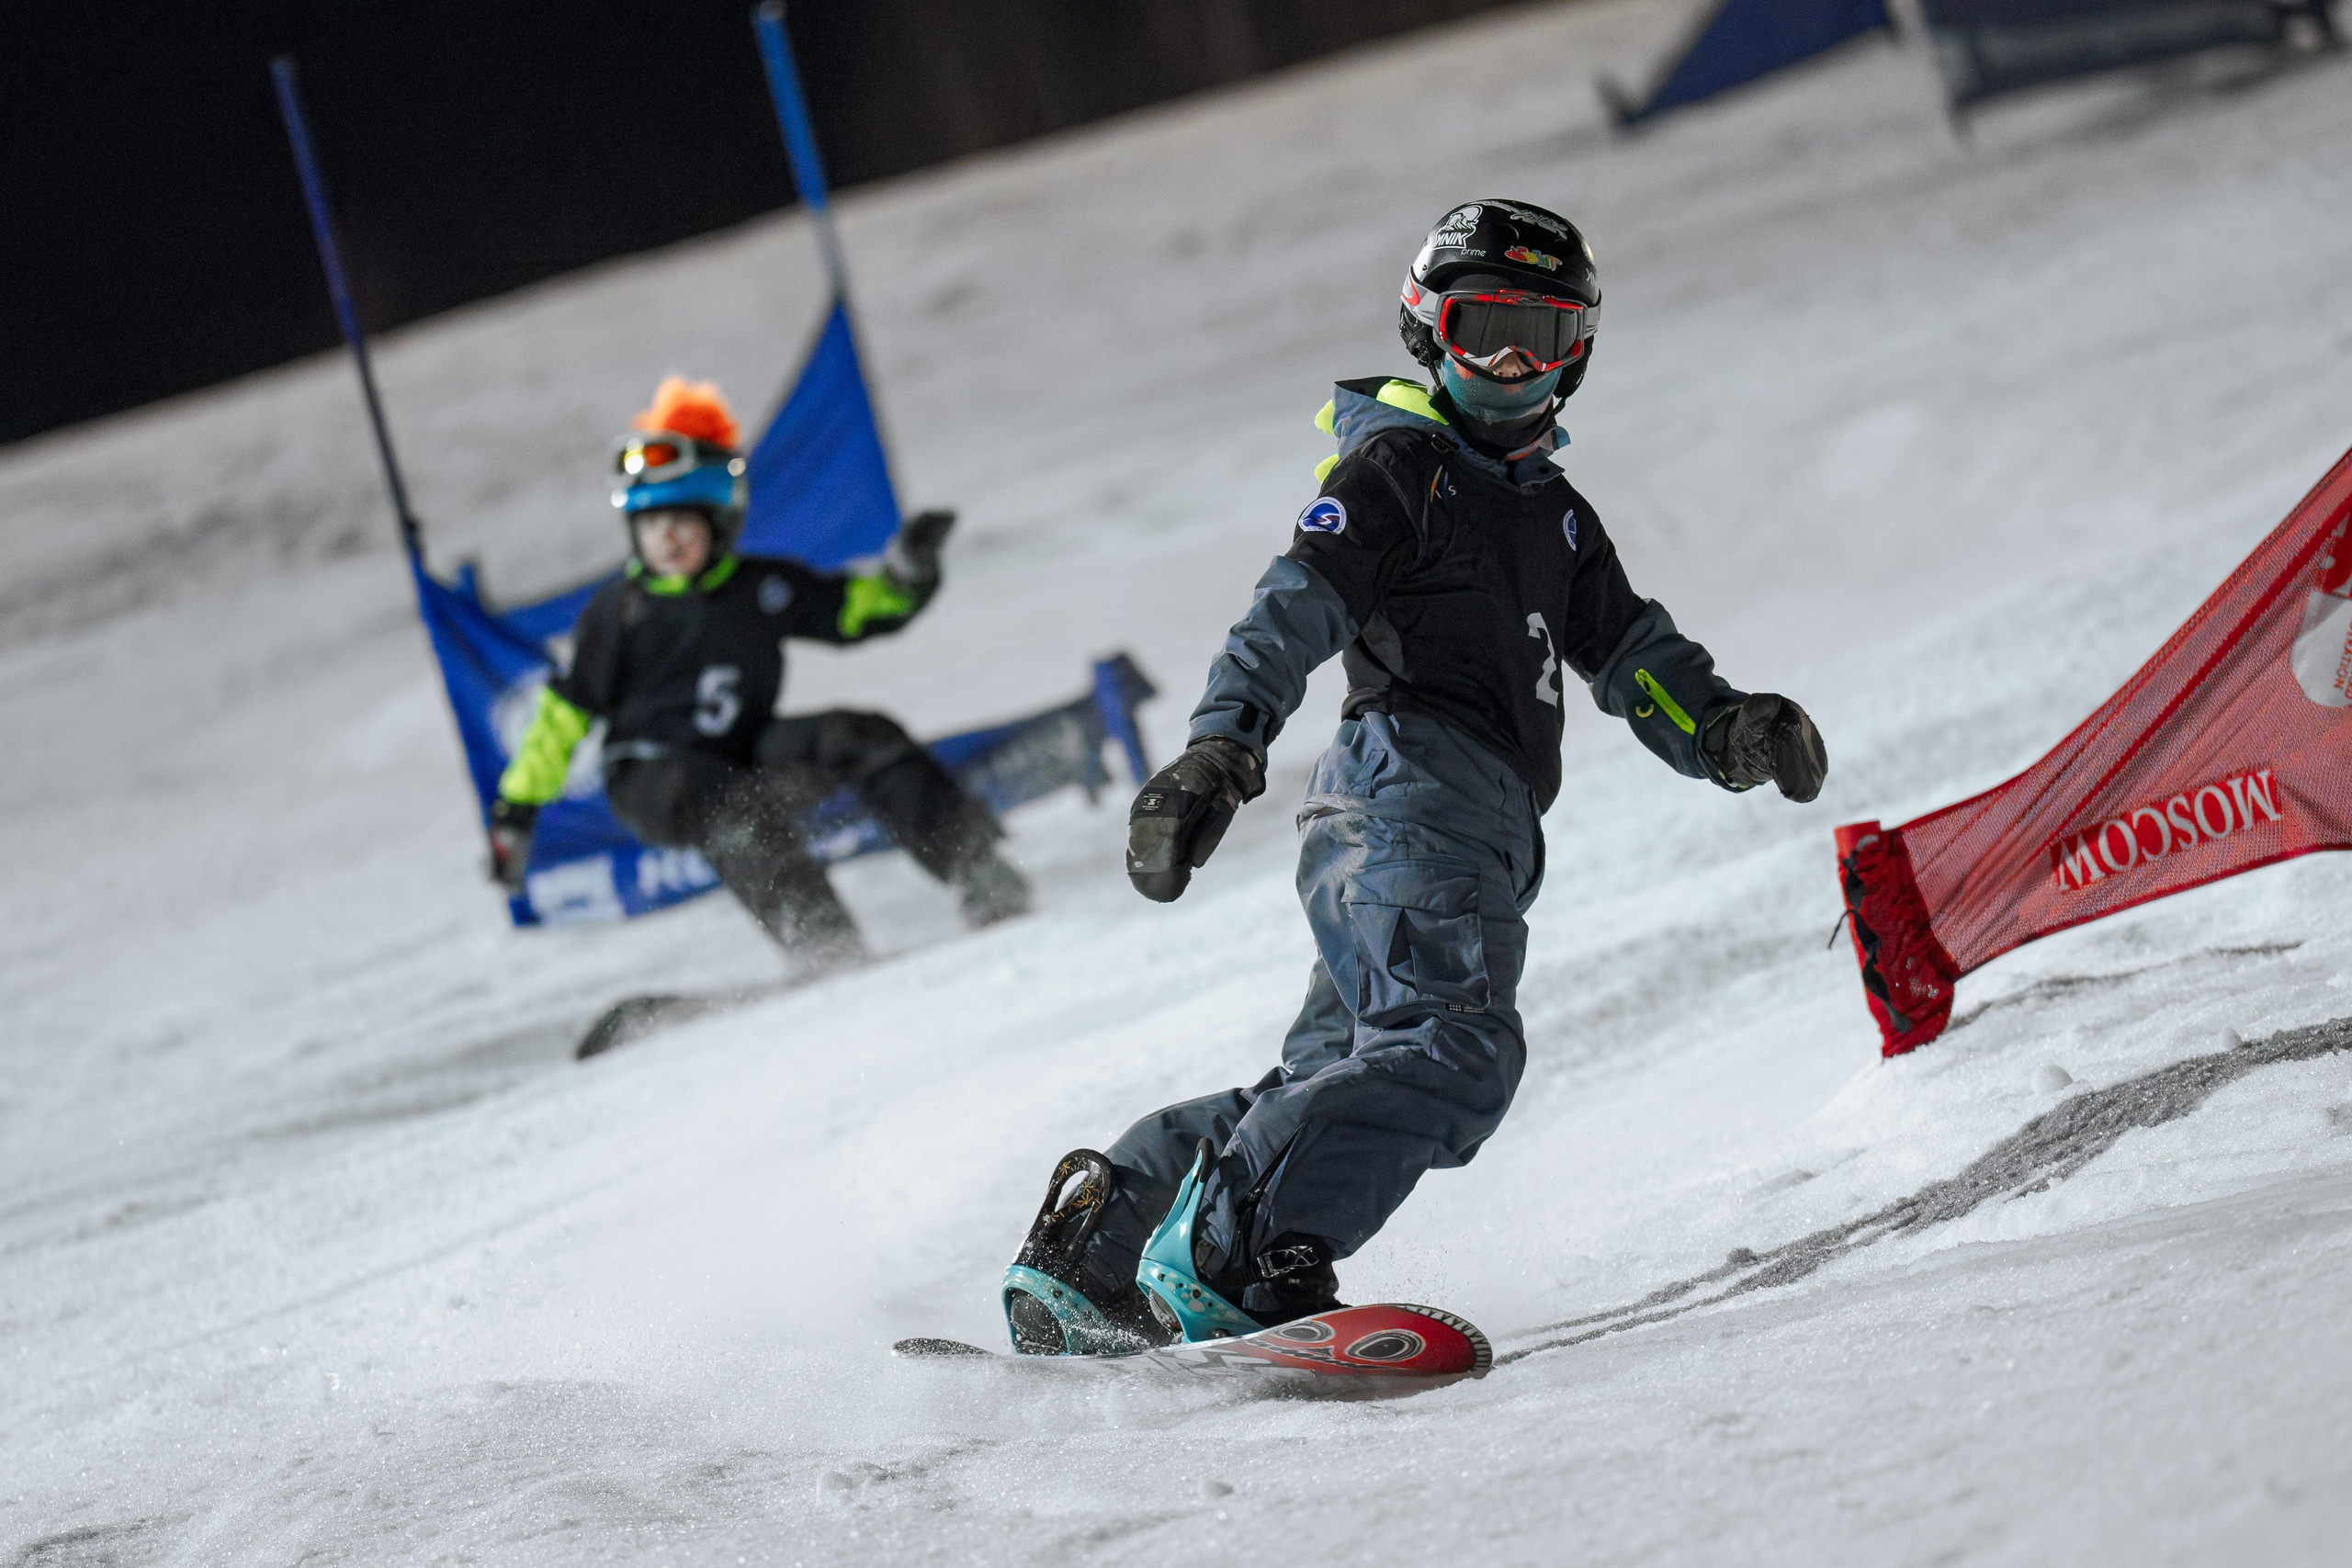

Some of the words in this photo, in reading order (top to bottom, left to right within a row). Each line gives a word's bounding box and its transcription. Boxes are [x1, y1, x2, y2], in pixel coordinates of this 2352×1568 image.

[1461, 248, 1487, 257] prime
[695, 664, 741, 736] 5
[1526, 612, 1559, 708] 2
[2058, 770, 2281, 890] MOSCOW
